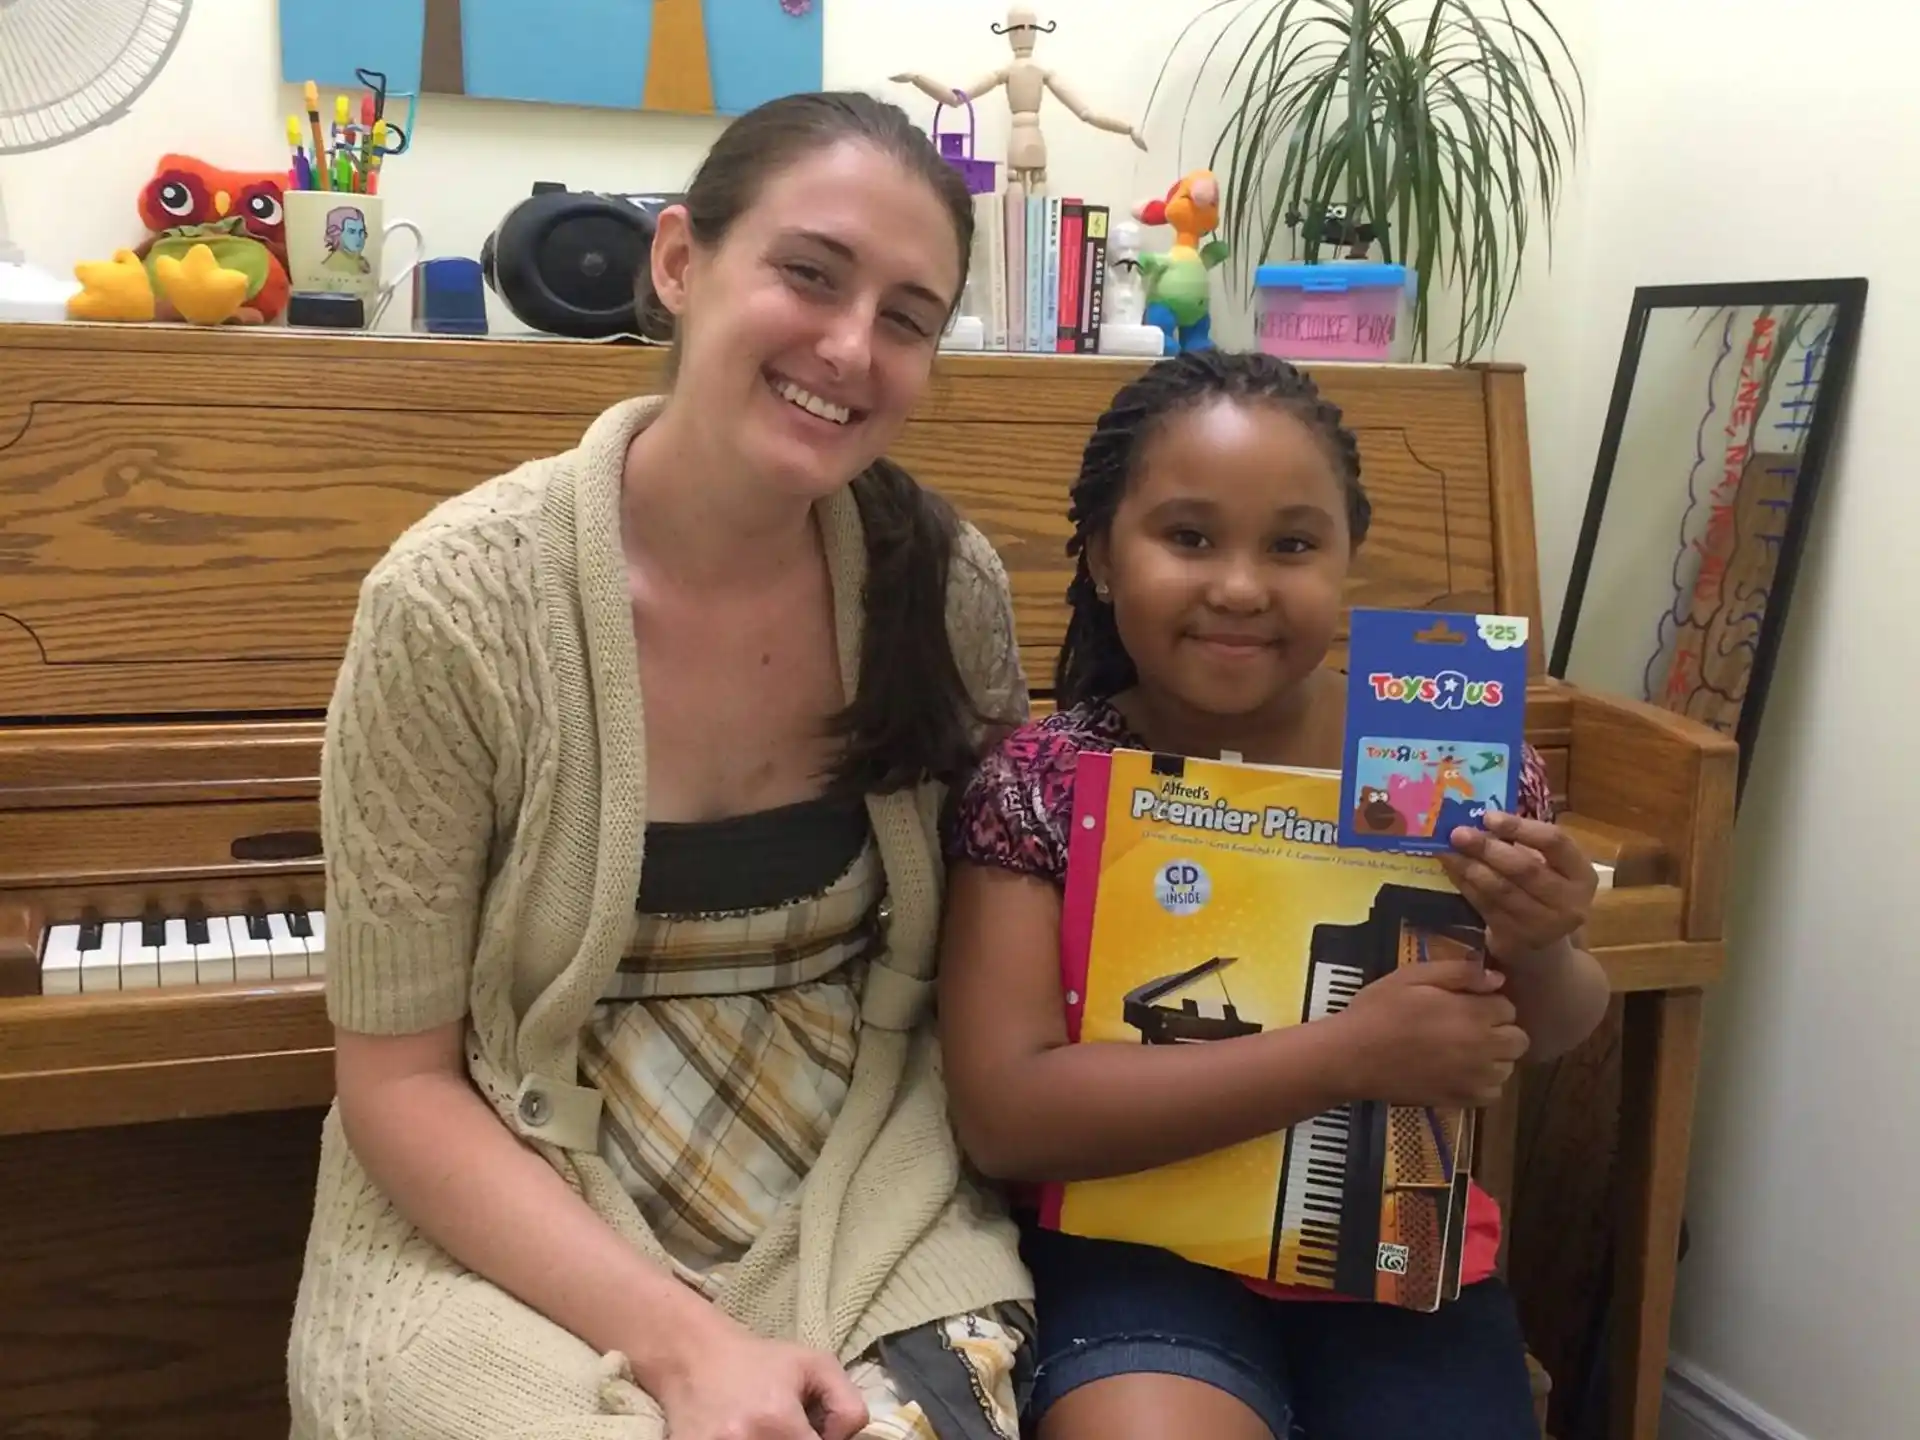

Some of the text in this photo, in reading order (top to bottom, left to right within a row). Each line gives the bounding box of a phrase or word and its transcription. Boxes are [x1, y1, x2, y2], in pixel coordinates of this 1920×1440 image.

[1486, 624, 1517, 641] $25
[1161, 780, 1210, 800] Alfred's
[1262, 805, 1338, 844] Pian
[1165, 865, 1198, 885] CD
[1166, 892, 1201, 905] INSIDE
[1380, 1244, 1407, 1254] Alfred
